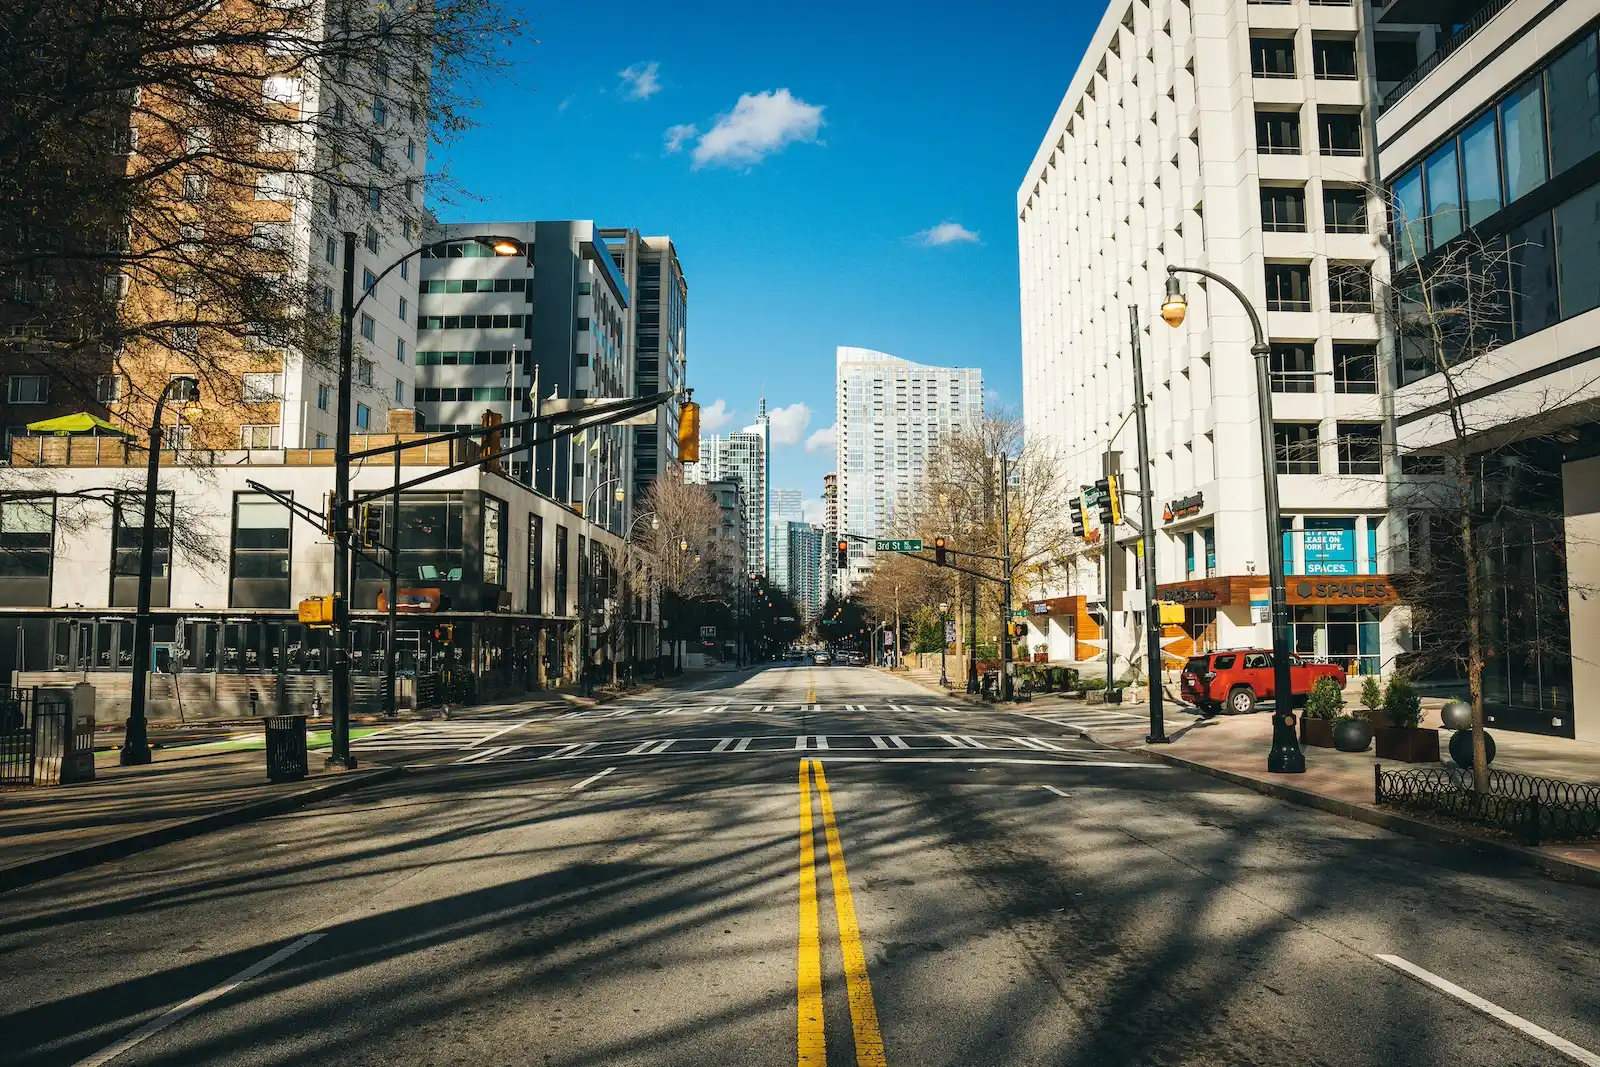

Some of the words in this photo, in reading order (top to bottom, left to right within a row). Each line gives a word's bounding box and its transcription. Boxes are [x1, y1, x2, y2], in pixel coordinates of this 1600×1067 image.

[877, 541, 890, 550] 3rd
[892, 541, 901, 550] St
[1308, 564, 1348, 573] SPACES.
